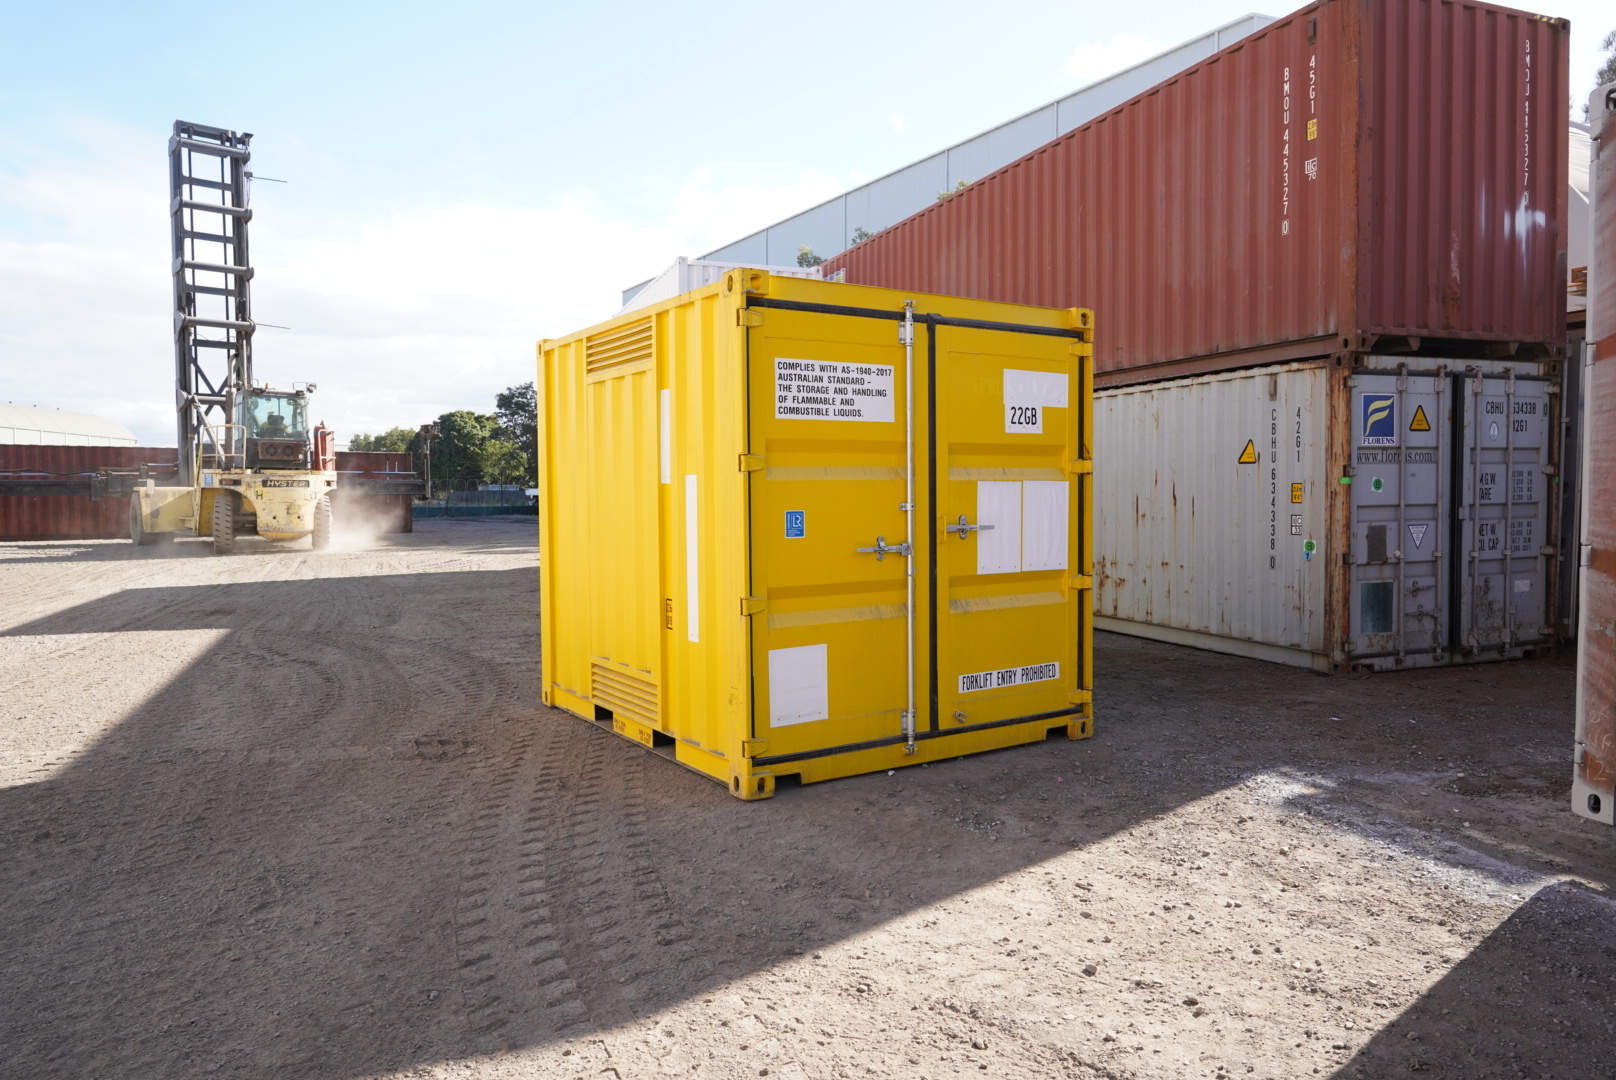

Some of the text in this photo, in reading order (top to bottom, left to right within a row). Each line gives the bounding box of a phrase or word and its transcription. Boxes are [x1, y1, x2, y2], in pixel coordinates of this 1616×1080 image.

[777, 361, 892, 377] COMPLIES WITH AS-1940-2017
[777, 372, 824, 384] AUSTRALIAN
[827, 375, 865, 386] STANDARD
[778, 383, 887, 398] THE STORAGE AND HANDLING
[778, 395, 855, 407] OF FLAMMABLE AND
[778, 405, 864, 418] COMBUSTIBLE LIQUIDS.
[1010, 406, 1037, 425] 22GB
[1485, 401, 1504, 415] CBHU
[1543, 403, 1548, 416] 0
[792, 515, 802, 528] LR
[1270, 555, 1275, 569] 0
[962, 663, 1056, 691] FORKLIFT ENTRY PROHIBITED
